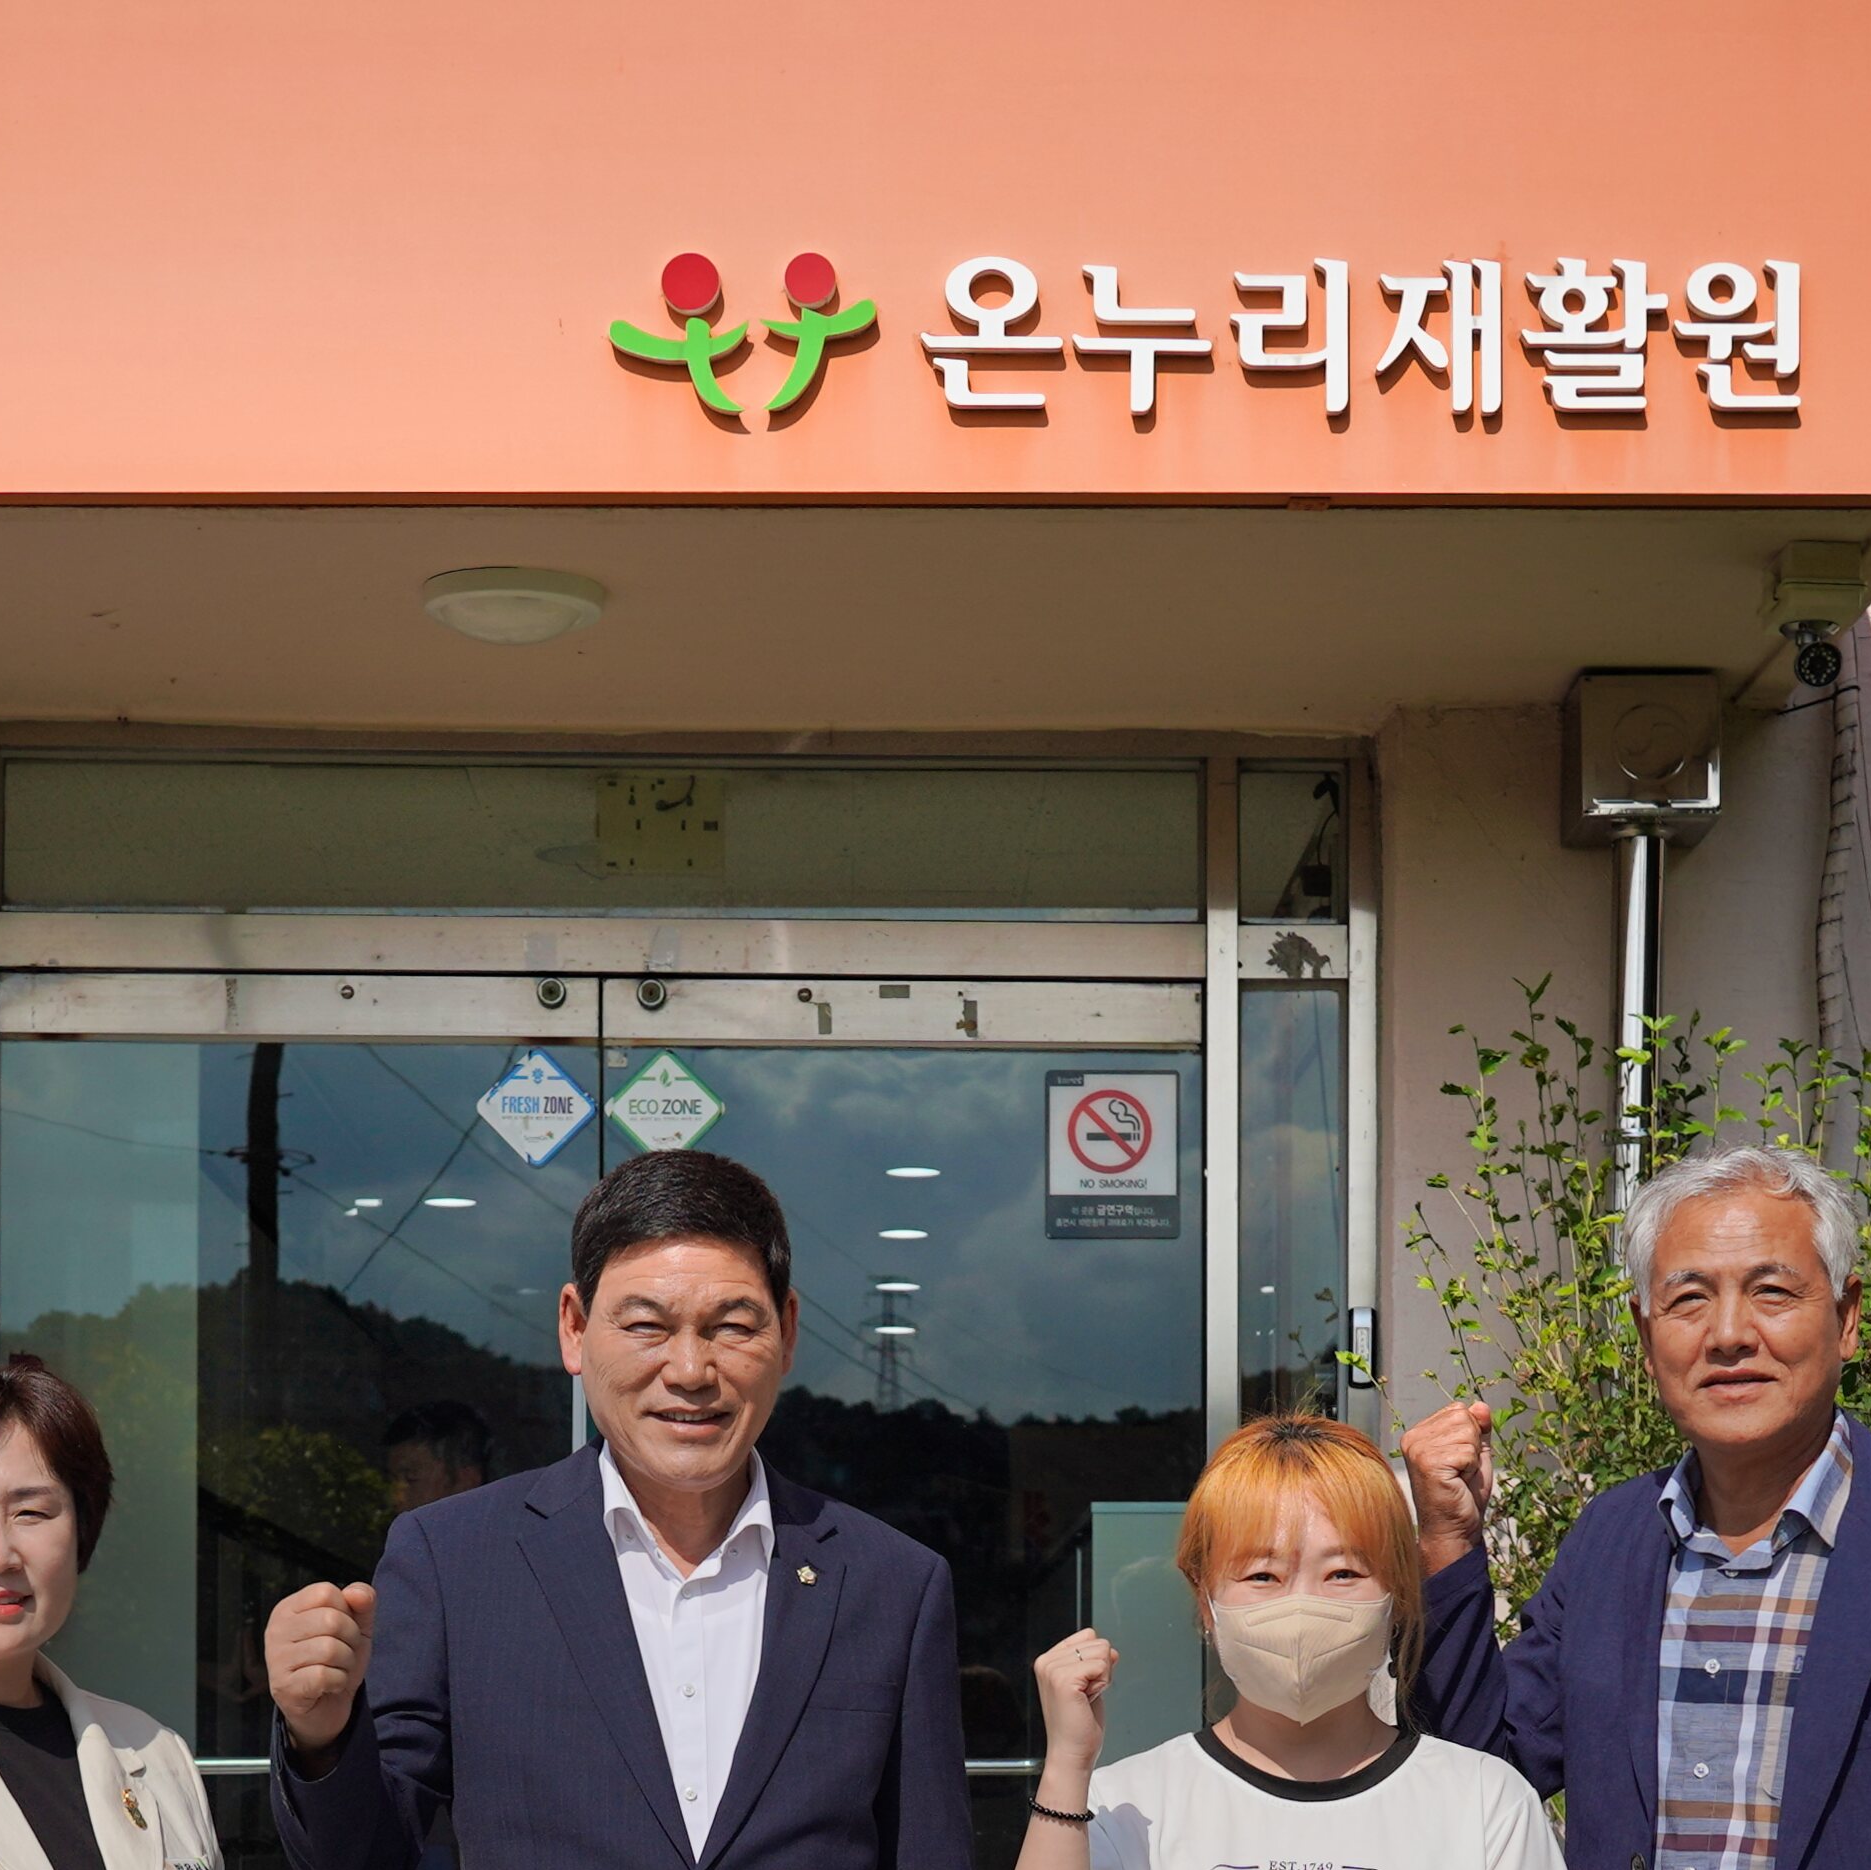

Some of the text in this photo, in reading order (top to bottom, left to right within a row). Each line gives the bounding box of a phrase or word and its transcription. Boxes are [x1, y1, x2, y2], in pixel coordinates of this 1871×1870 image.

[921, 256, 1801, 421] 온누리재활원
[502, 1096, 573, 1114] FRESH ZONE
[629, 1098, 701, 1115] ECO ZONE
[1080, 1179, 1147, 1189] NO SMOKING!
